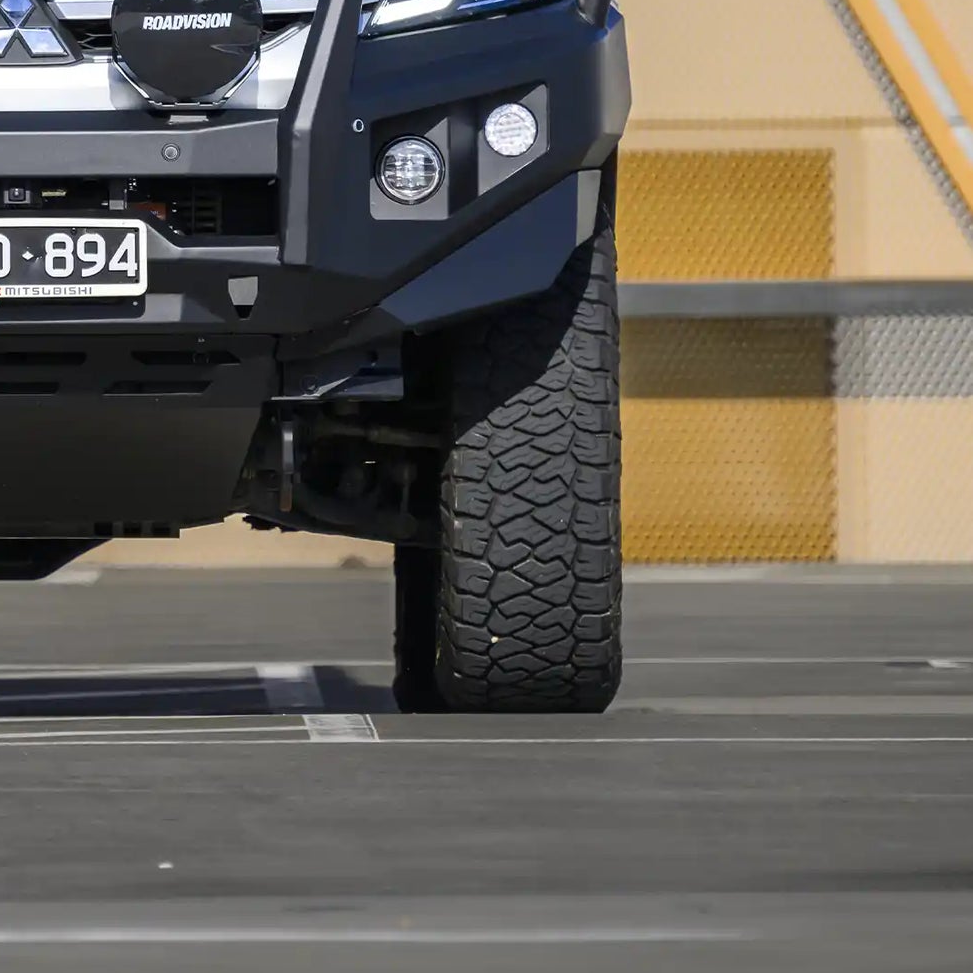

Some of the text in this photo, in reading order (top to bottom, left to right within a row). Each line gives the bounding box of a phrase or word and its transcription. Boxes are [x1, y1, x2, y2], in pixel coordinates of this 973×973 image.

[142, 13, 232, 30] ROADVISION
[45, 232, 138, 278] 894
[5, 286, 93, 296] MITSUBISHI
